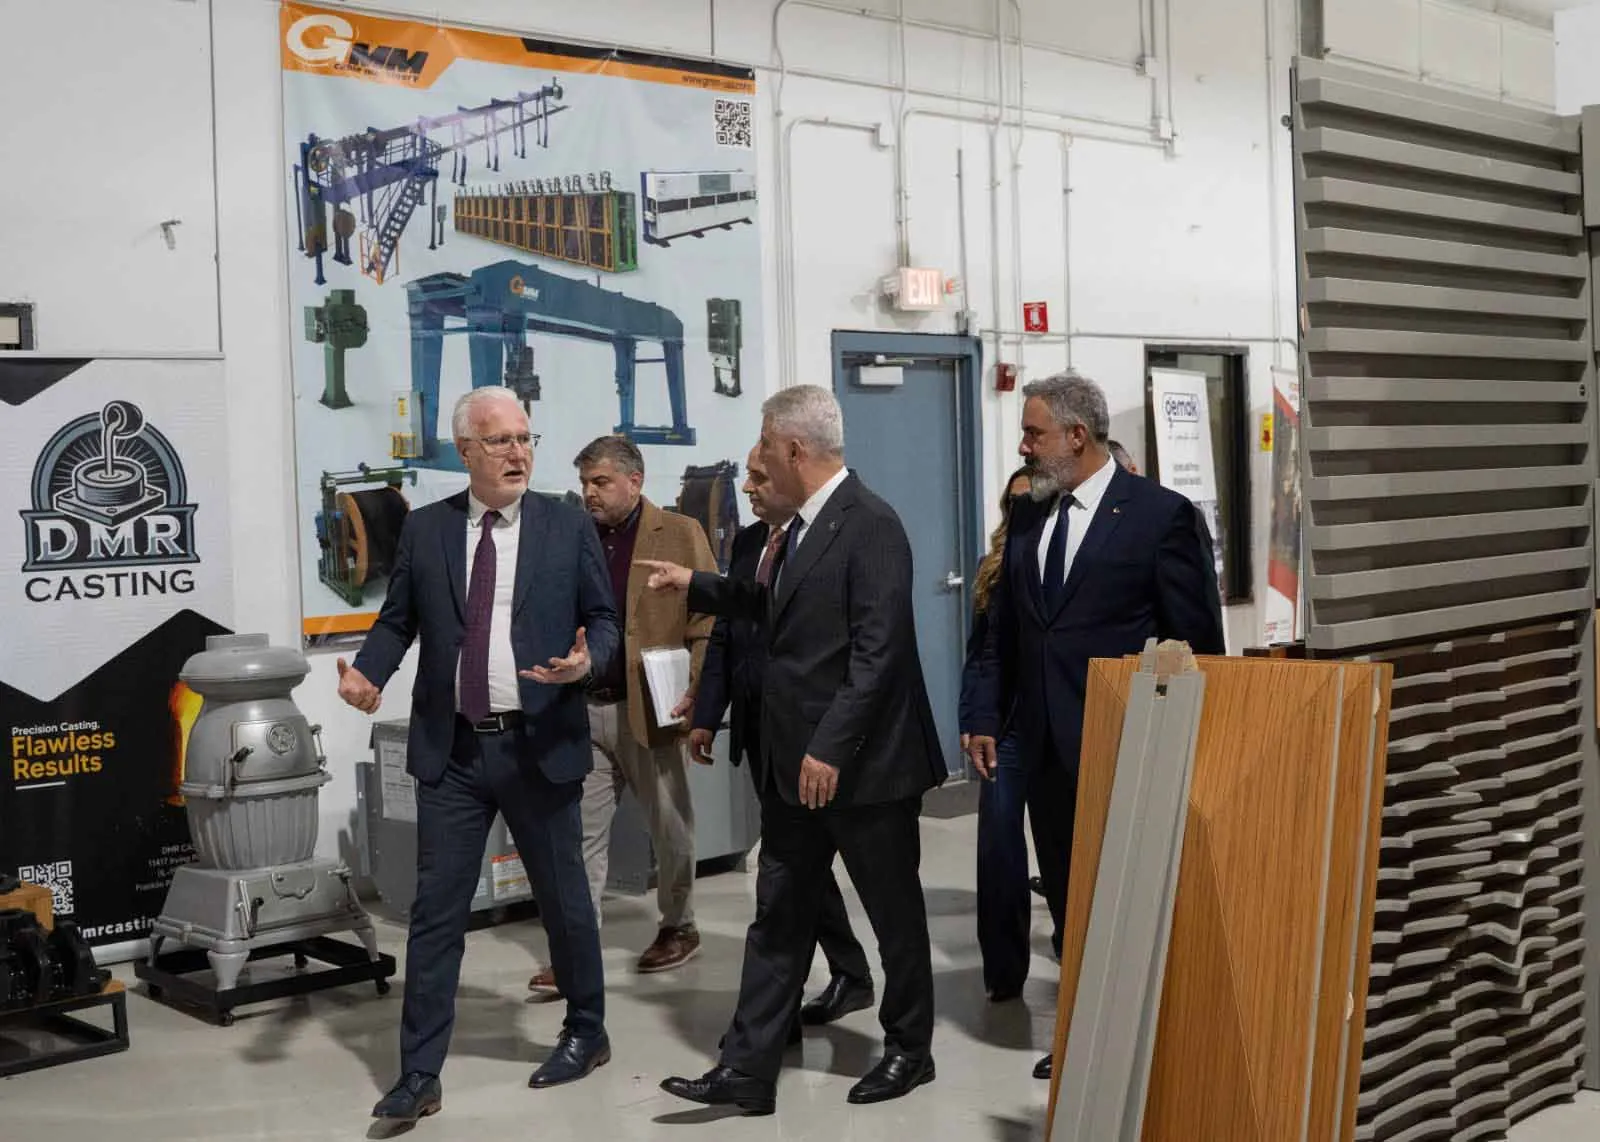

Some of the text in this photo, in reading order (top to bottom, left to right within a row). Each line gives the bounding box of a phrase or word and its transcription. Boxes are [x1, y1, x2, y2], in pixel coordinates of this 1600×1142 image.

[286, 14, 429, 74] GMM
[908, 271, 939, 305] EXIT
[33, 514, 187, 562] DMR
[24, 569, 196, 602] CASTING
[12, 724, 58, 736] Precision
[12, 731, 116, 757] Flawless
[13, 753, 103, 780] Results
